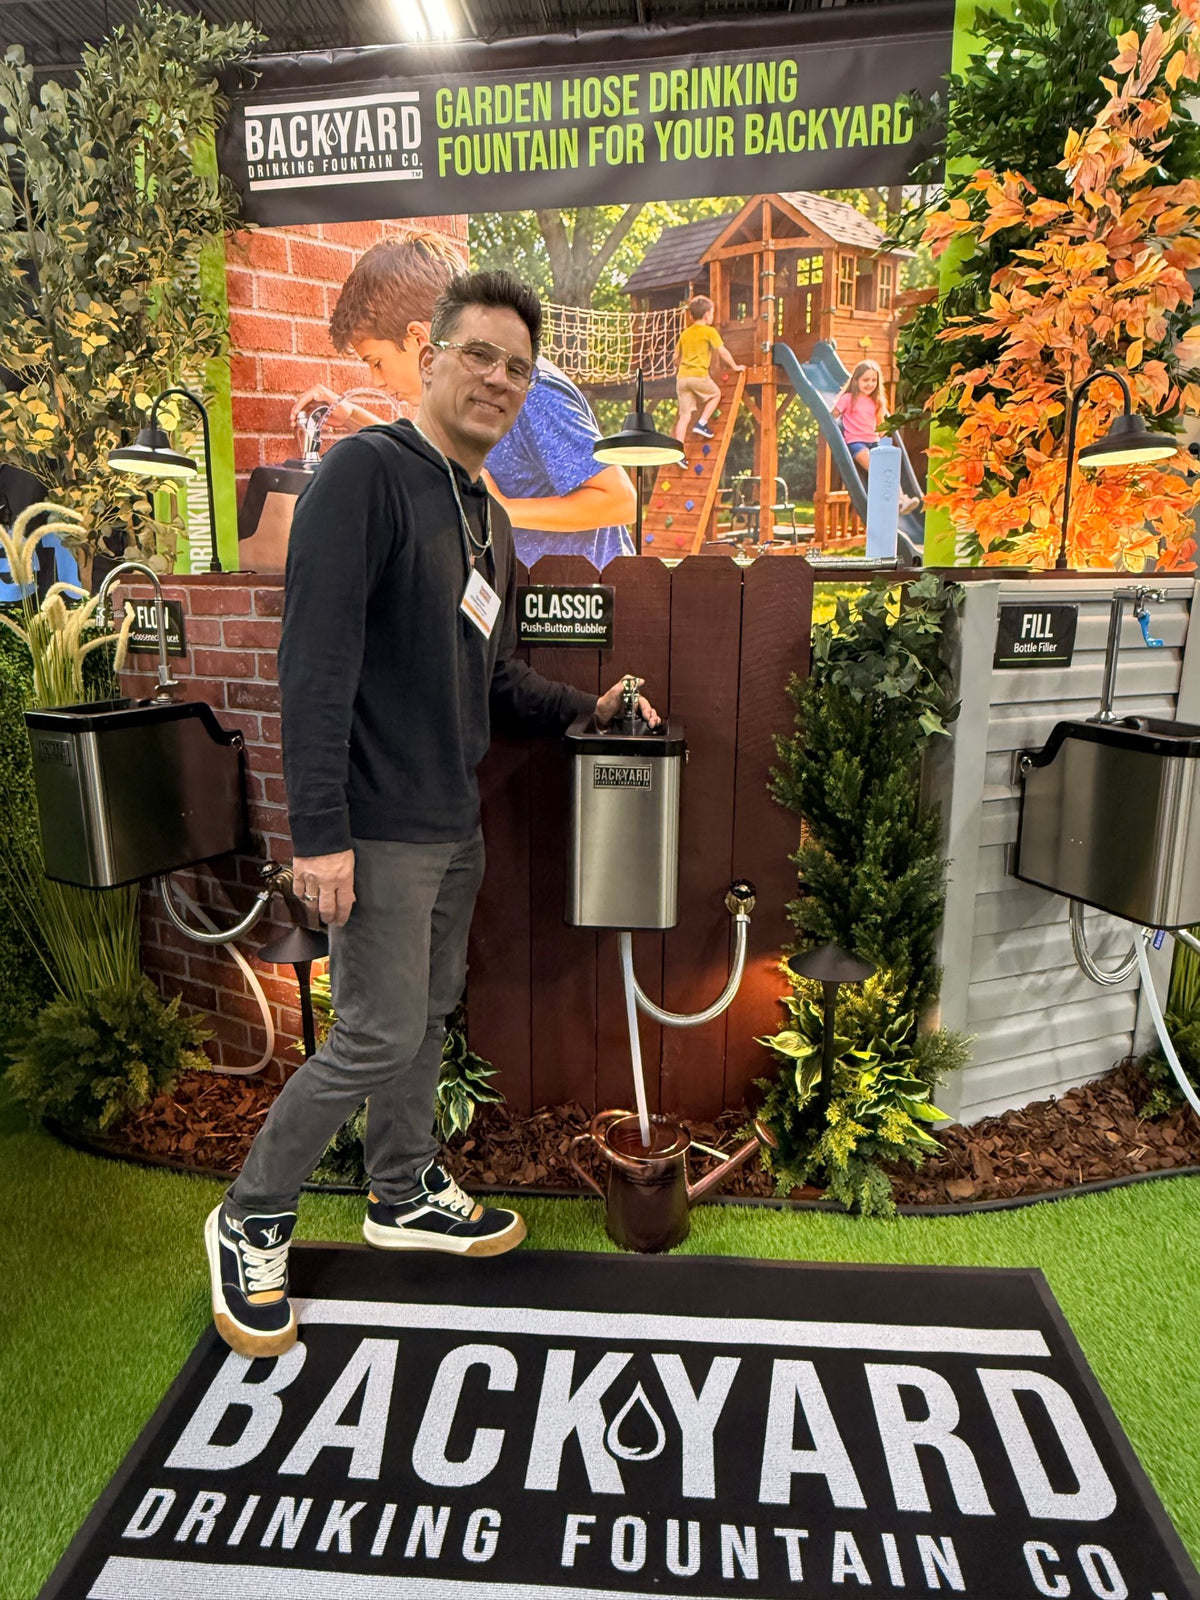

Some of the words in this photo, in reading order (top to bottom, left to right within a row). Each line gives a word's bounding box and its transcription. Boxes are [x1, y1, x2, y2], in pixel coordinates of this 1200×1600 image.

[435, 81, 552, 129] GARDEN
[562, 74, 640, 120] HOSE
[649, 59, 798, 114] DRINKING
[244, 105, 422, 162] BACKYARD
[437, 128, 579, 178] FOUNTAIN
[588, 123, 645, 167] FOR
[653, 116, 735, 162] YOUR
[744, 101, 914, 156] BACKYARD
[248, 160, 315, 179] DRINKING
[323, 154, 393, 172] FOUNTAIN
[401, 153, 423, 167] CO.
[136, 606, 169, 629] FLO
[525, 593, 604, 619] CLASSIC
[520, 622, 573, 633] Push-Button
[574, 622, 608, 634] Bubbler
[1021, 613, 1054, 639] FILL
[1013, 642, 1038, 653] Bottle
[1038, 641, 1058, 652] Filler
[594, 768, 650, 782] BACKYARD
[163, 1337, 1117, 1521] BACKYARD
[121, 1487, 502, 1563] DRINKING
[561, 1513, 967, 1592] FOUNTAIN
